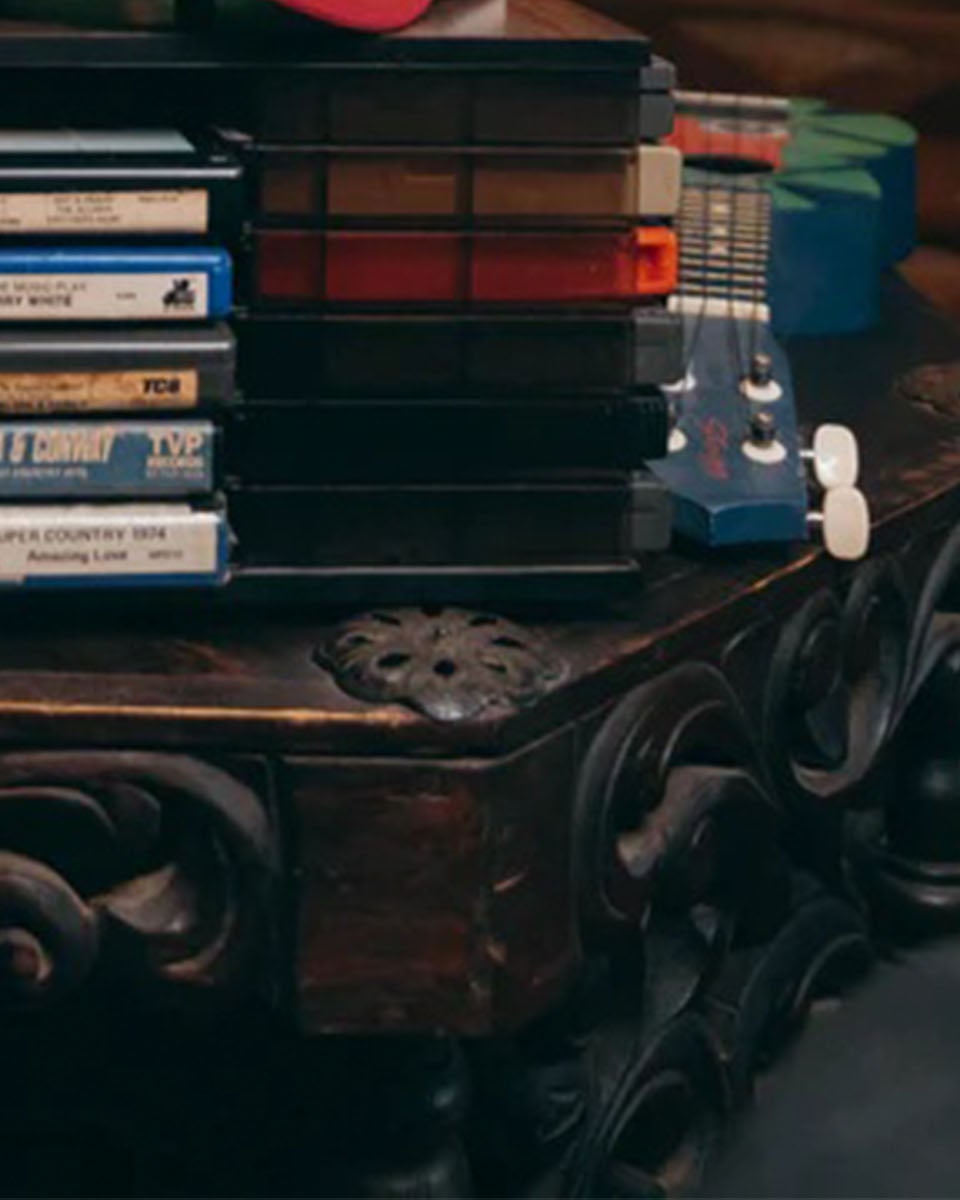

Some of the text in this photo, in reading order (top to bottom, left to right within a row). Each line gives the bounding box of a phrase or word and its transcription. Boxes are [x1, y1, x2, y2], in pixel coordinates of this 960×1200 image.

[28, 294, 73, 308] WHITE
[145, 432, 204, 456] TVP
[44, 527, 126, 542] COUNTRY
[28, 549, 89, 564] Amazing
